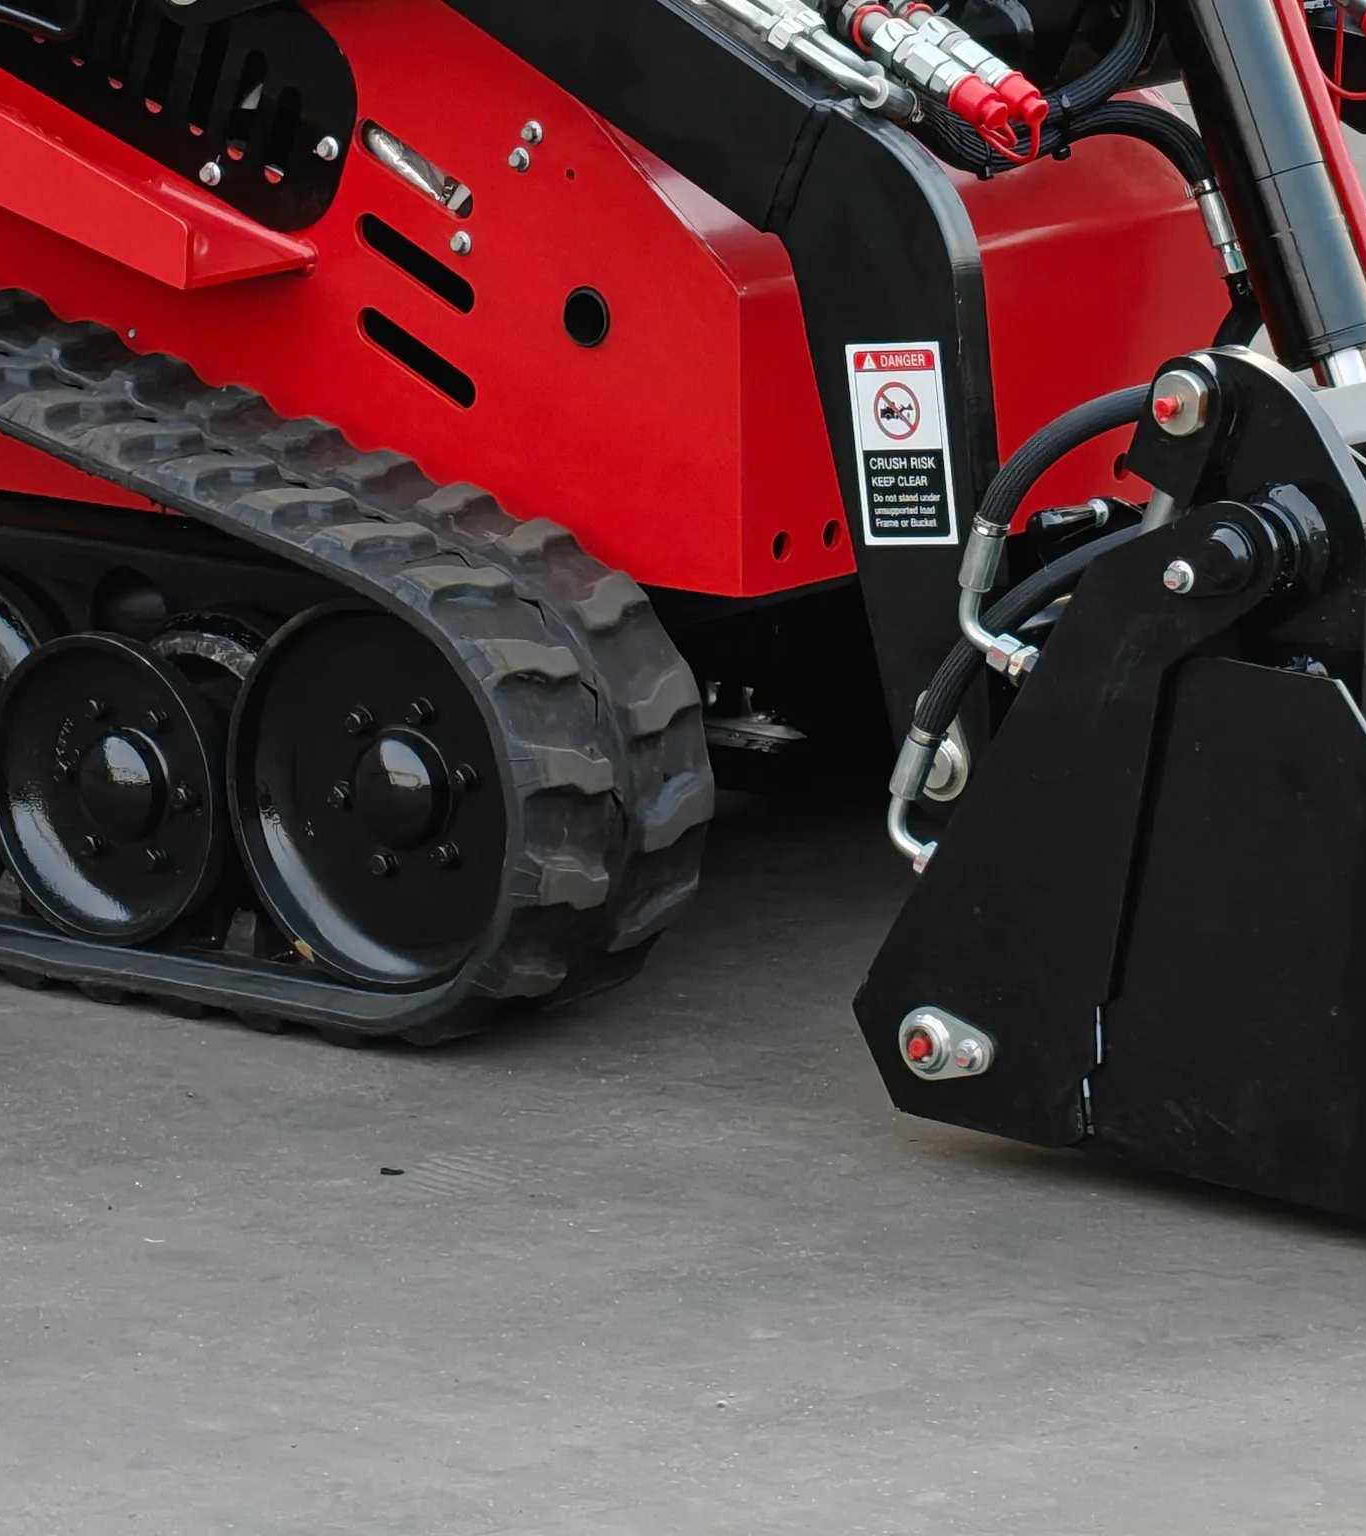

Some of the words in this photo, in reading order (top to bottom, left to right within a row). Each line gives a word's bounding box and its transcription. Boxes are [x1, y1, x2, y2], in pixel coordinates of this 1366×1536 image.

[880, 353, 926, 368] DANGER
[869, 457, 908, 470] CRUSH
[910, 456, 936, 470] RISK
[871, 476, 895, 487] KEEP
[897, 475, 928, 487] CLEAR
[873, 493, 884, 503] Do
[885, 493, 897, 503] not
[898, 493, 919, 502] stand
